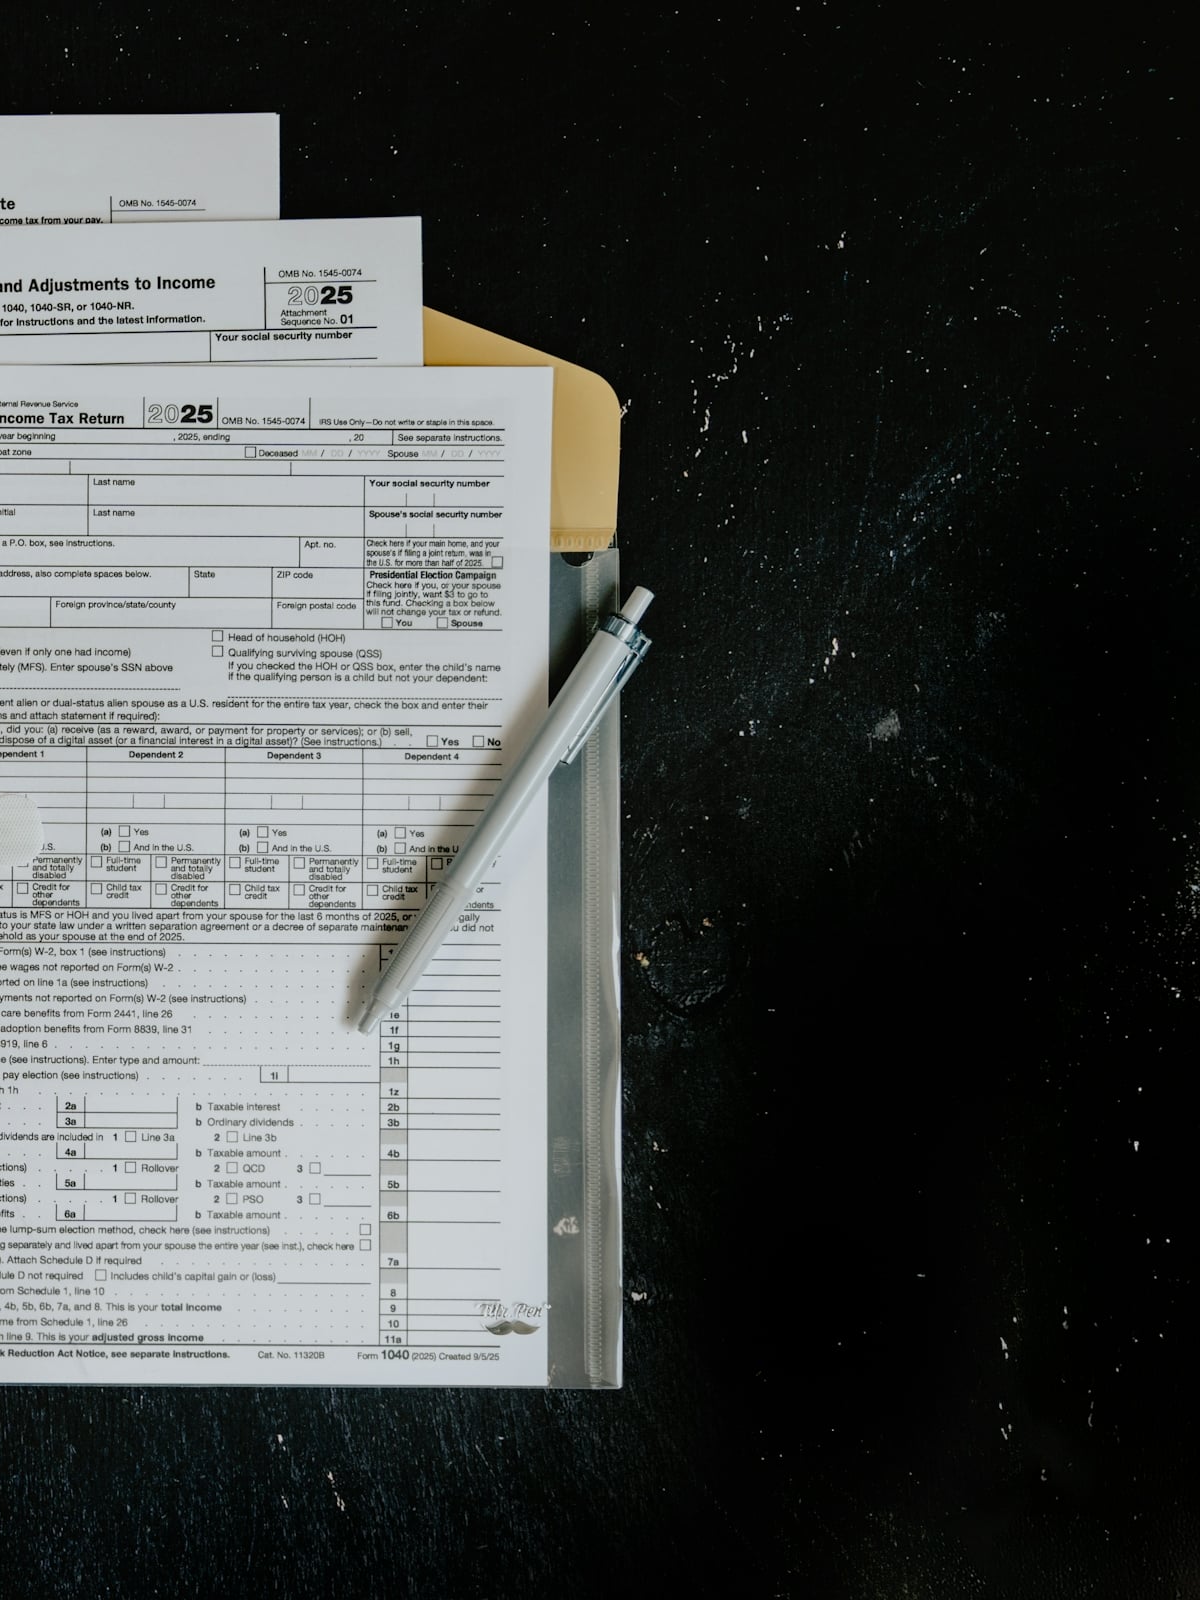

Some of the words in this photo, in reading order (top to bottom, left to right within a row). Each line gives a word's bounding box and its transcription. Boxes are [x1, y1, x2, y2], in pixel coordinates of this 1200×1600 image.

[118, 199, 138, 207] OMB
[140, 199, 153, 207] No.
[156, 199, 196, 207] 1545-0074
[278, 269, 299, 278] OMB
[301, 269, 315, 277] No.
[318, 268, 362, 277] 1545-0074
[28, 277, 129, 295] Adjustments
[134, 277, 151, 290] to
[157, 276, 215, 289] Income
[287, 286, 353, 305] 2025
[2, 303, 27, 313] 1040,
[30, 302, 73, 312] 1040-SR,
[90, 301, 134, 310] 1040-NR.
[280, 308, 327, 317] Attachment
[0, 318, 13, 327] for
[16, 317, 74, 326] instructions
[76, 316, 95, 325] and
[97, 316, 113, 325] the
[116, 315, 144, 324] latest
[146, 314, 205, 324] information.
[280, 317, 321, 327] Sequence
[323, 317, 337, 325] No.
[340, 314, 354, 325] 01
[215, 333, 240, 342] Your
[242, 332, 270, 341] social
[272, 331, 312, 341] security
[313, 331, 353, 339] number
[48, 412, 73, 424] Tax
[79, 412, 124, 424] Return
[148, 404, 213, 423] 2025
[221, 416, 243, 424] OMB
[262, 417, 305, 425] 1545-0074
[369, 479, 390, 487] Your
[392, 479, 417, 487] social
[419, 479, 454, 488] security
[456, 479, 490, 487] number
[276, 570, 291, 578] ZIP
[369, 570, 418, 579] Presidential
[420, 570, 453, 579] Election
[455, 570, 496, 581] Campaign
[395, 619, 413, 627] You
[451, 619, 483, 628] Spouse
[441, 737, 459, 746] Yes
[487, 737, 501, 746] No
[34, 946, 56, 956] W-2,
[59, 947, 77, 956] box
[88, 947, 107, 958] (see
[109, 947, 166, 958] instructions)
[257, 1350, 274, 1359] Cat.
[276, 1351, 290, 1359] No.
[294, 1351, 325, 1359] 11320B
[357, 1351, 378, 1360] Form
[381, 1349, 409, 1360] 1040
[411, 1352, 436, 1361] (2025)
[438, 1351, 471, 1360] Created
[473, 1352, 499, 1361] 9/5/25
